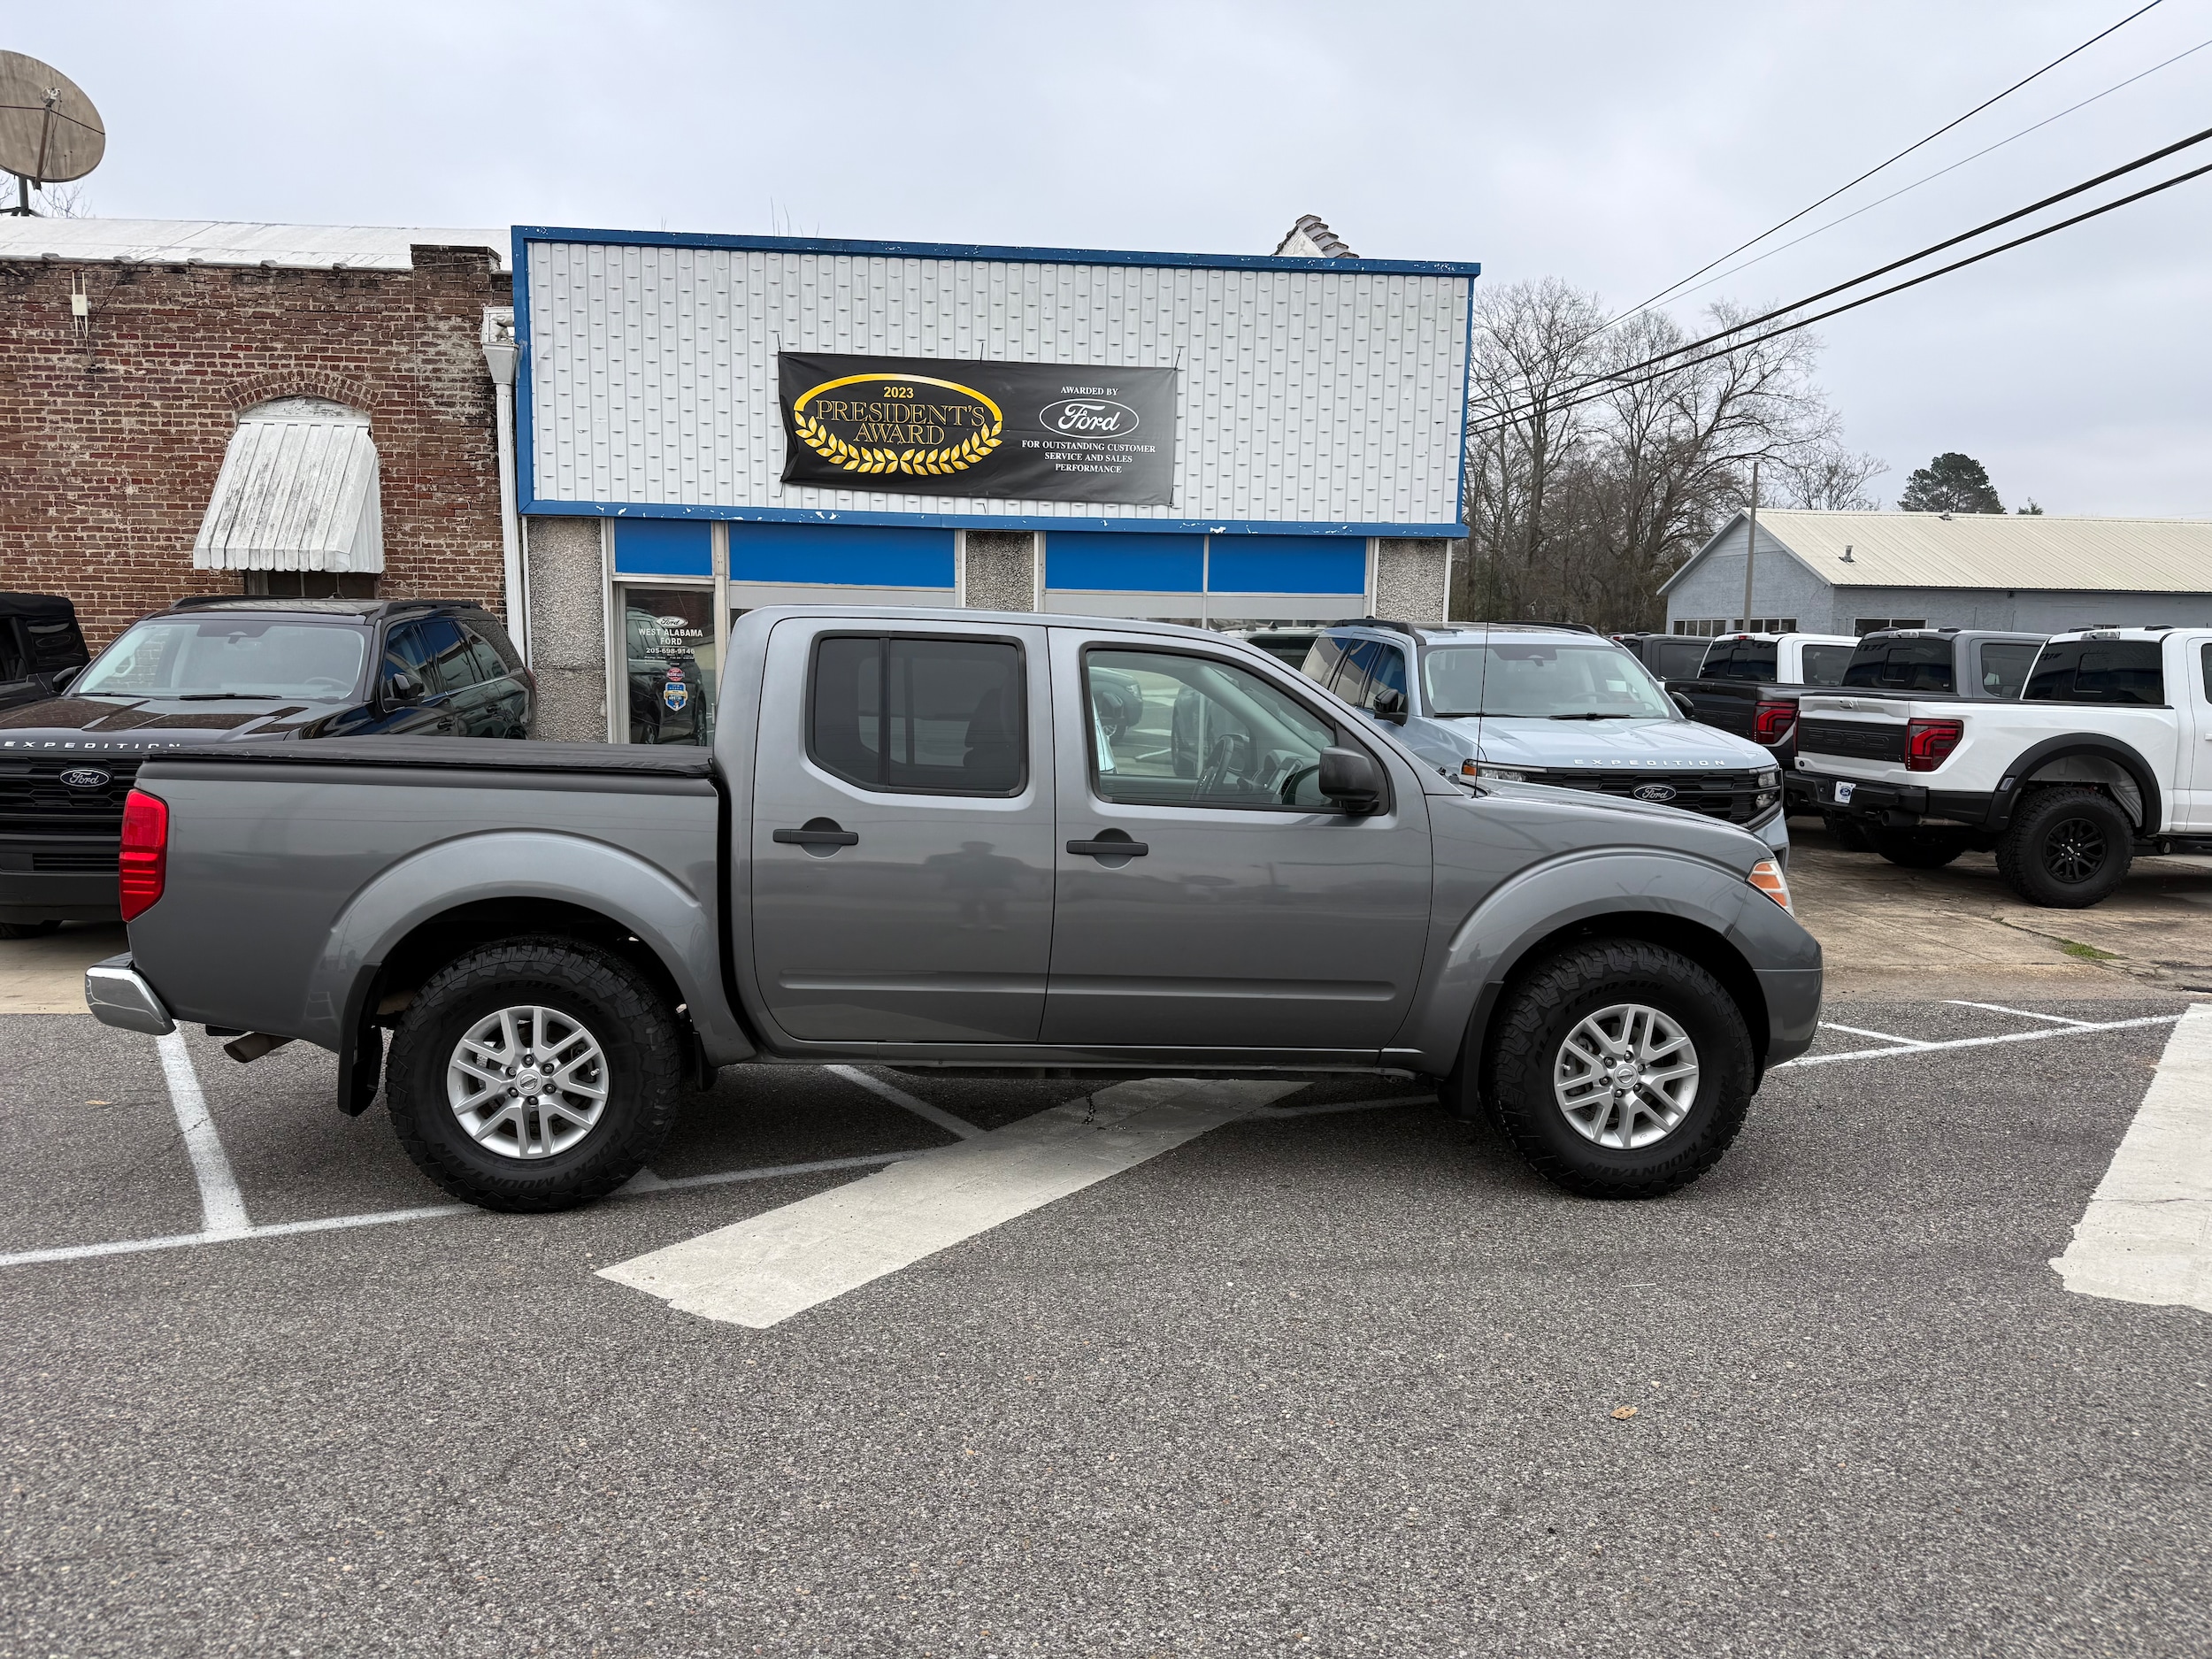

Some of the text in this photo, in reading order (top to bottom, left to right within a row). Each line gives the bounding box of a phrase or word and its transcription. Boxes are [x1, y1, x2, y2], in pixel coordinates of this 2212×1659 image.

[883, 386, 914, 399] 2023
[1060, 386, 1118, 396] AWARDED BY
[815, 399, 986, 426] PRESIDENT'S
[1057, 403, 1121, 431] Ford
[853, 422, 945, 445] AWARD
[1022, 440, 1156, 453] FOR OUTSTANDING CUSTOMER
[1044, 452, 1133, 463] SERVICE AND SALES
[1055, 464, 1122, 473] PERFORMANCE
[664, 628, 703, 637] ALABAMA
[1808, 729, 1890, 749] FORD
[1573, 758, 1726, 767] EXPEDITION
[69, 772, 99, 785] Ford
[1641, 787, 1669, 800] Ford
[1563, 979, 1665, 1015] TERRAIN
[433, 1142, 557, 1189] MOUNTAIN
